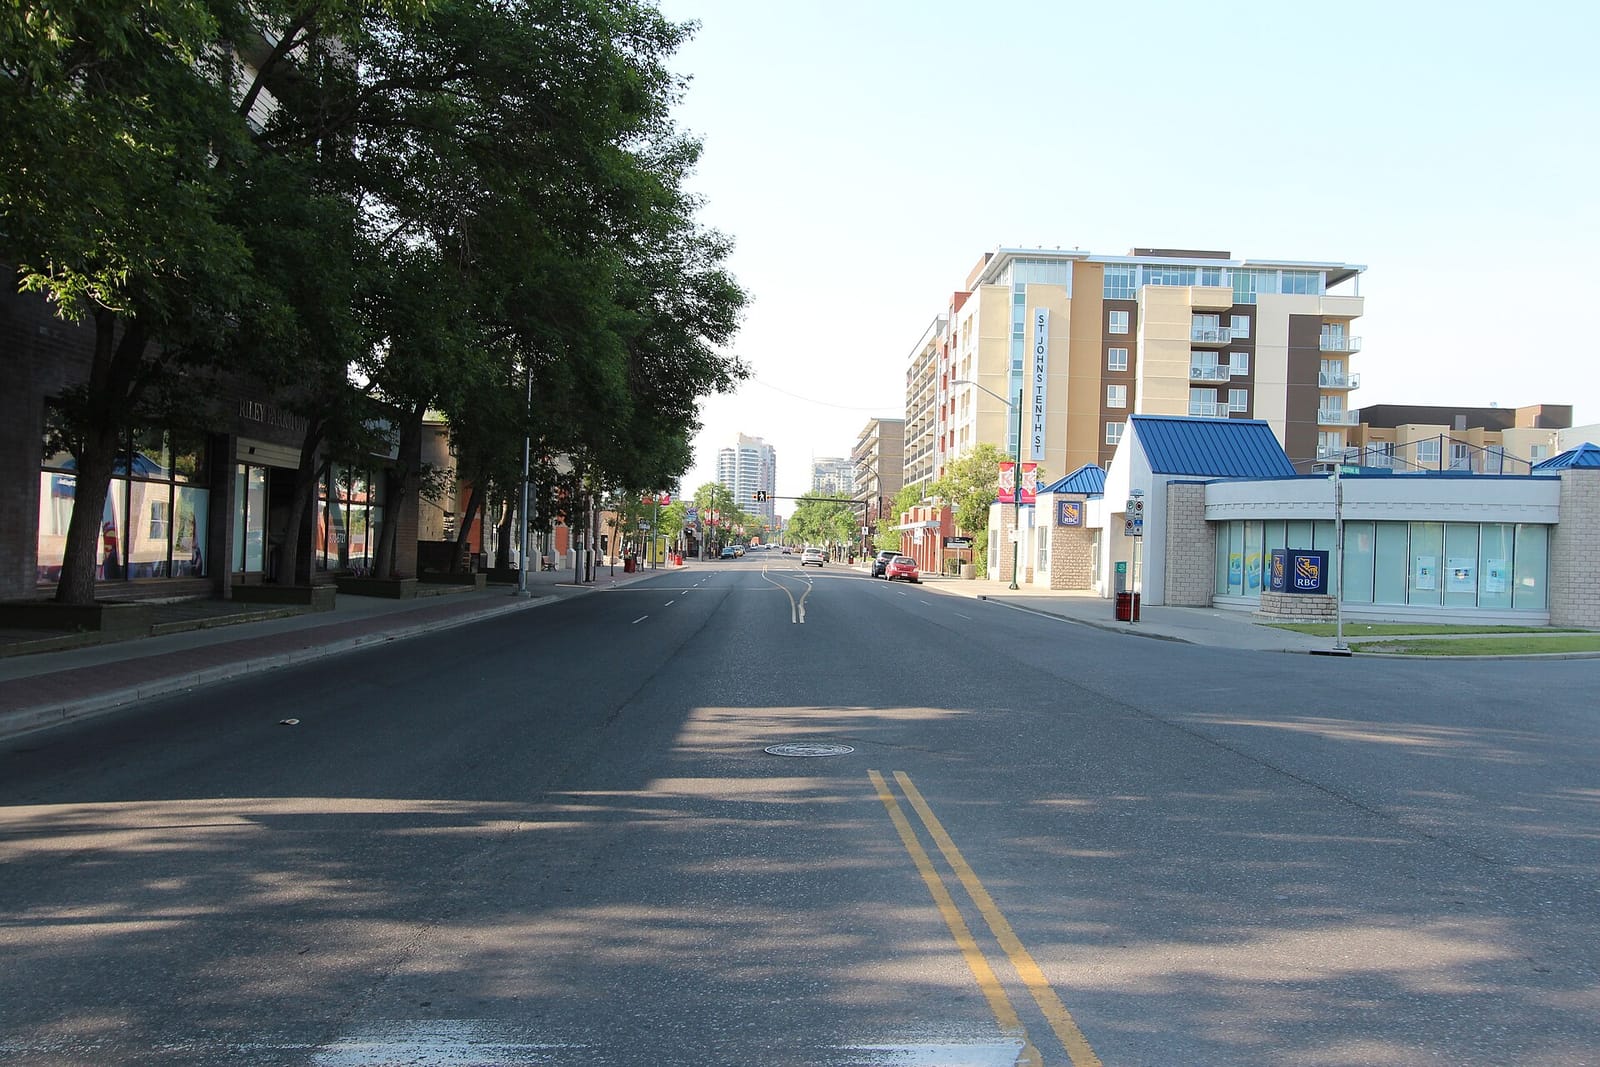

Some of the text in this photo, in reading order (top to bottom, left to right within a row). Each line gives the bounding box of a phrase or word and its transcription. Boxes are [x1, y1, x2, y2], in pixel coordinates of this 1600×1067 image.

[1034, 314, 1045, 453] ST JOHNS TENTH ST
[239, 399, 265, 422] RILEY
[1297, 579, 1317, 587] RBC
